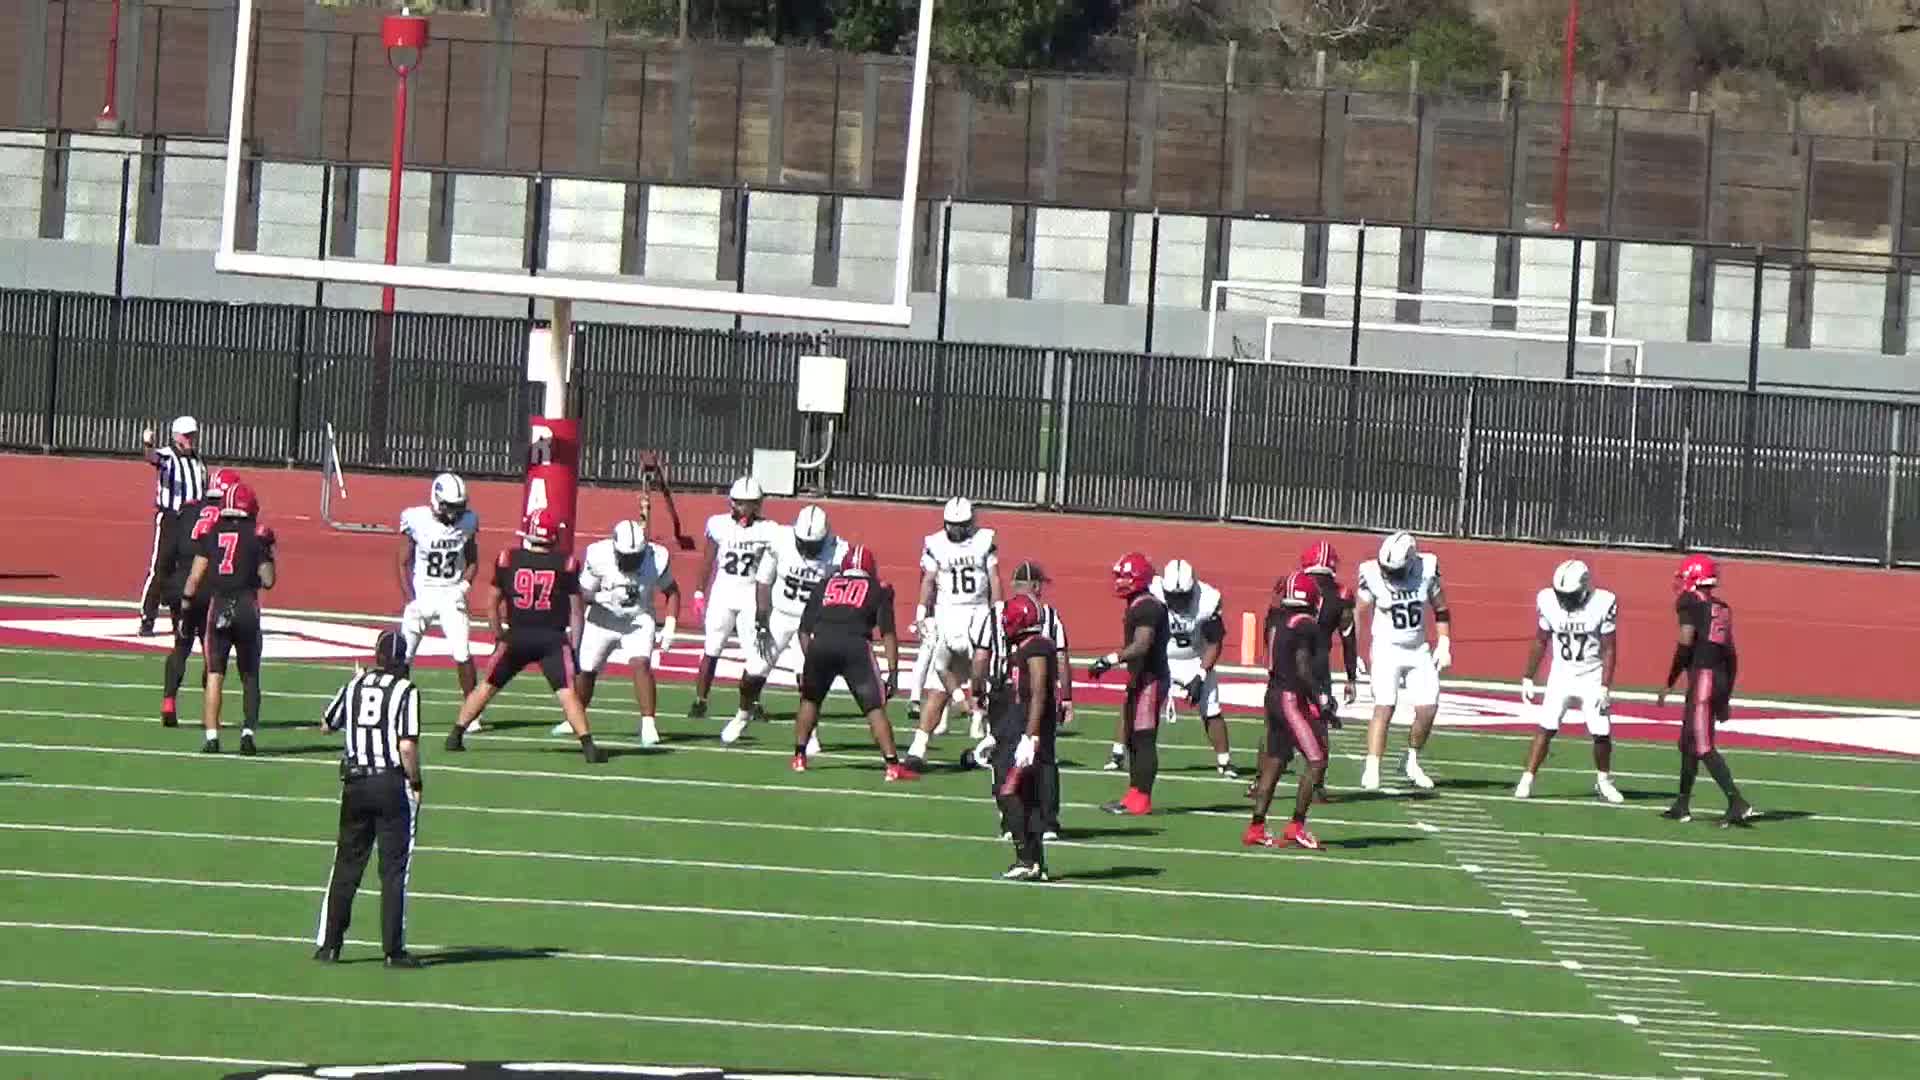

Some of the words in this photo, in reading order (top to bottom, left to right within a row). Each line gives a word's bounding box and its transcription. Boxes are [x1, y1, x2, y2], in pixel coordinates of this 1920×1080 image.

[218, 532, 239, 575] 7
[427, 551, 461, 579] 83
[724, 551, 756, 577] 27
[513, 568, 556, 611] 97
[823, 577, 869, 609] 50
[951, 566, 976, 595] 16
[1391, 600, 1422, 630] 66
[1557, 632, 1588, 662] 87
